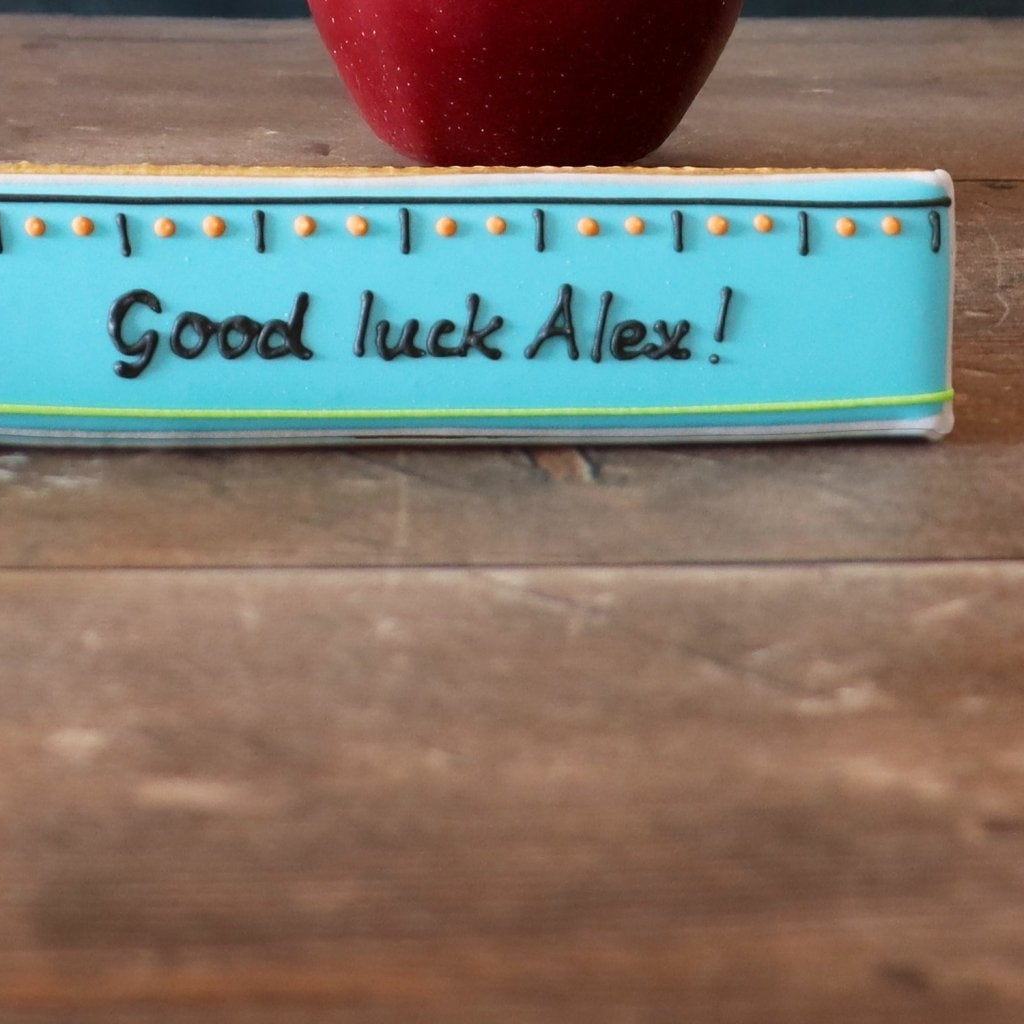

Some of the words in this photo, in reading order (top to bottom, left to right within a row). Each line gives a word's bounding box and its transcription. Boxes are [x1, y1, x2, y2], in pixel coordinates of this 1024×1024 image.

[106, 288, 314, 380] Good
[352, 290, 504, 362] luck
[523, 283, 733, 365] Alex!
